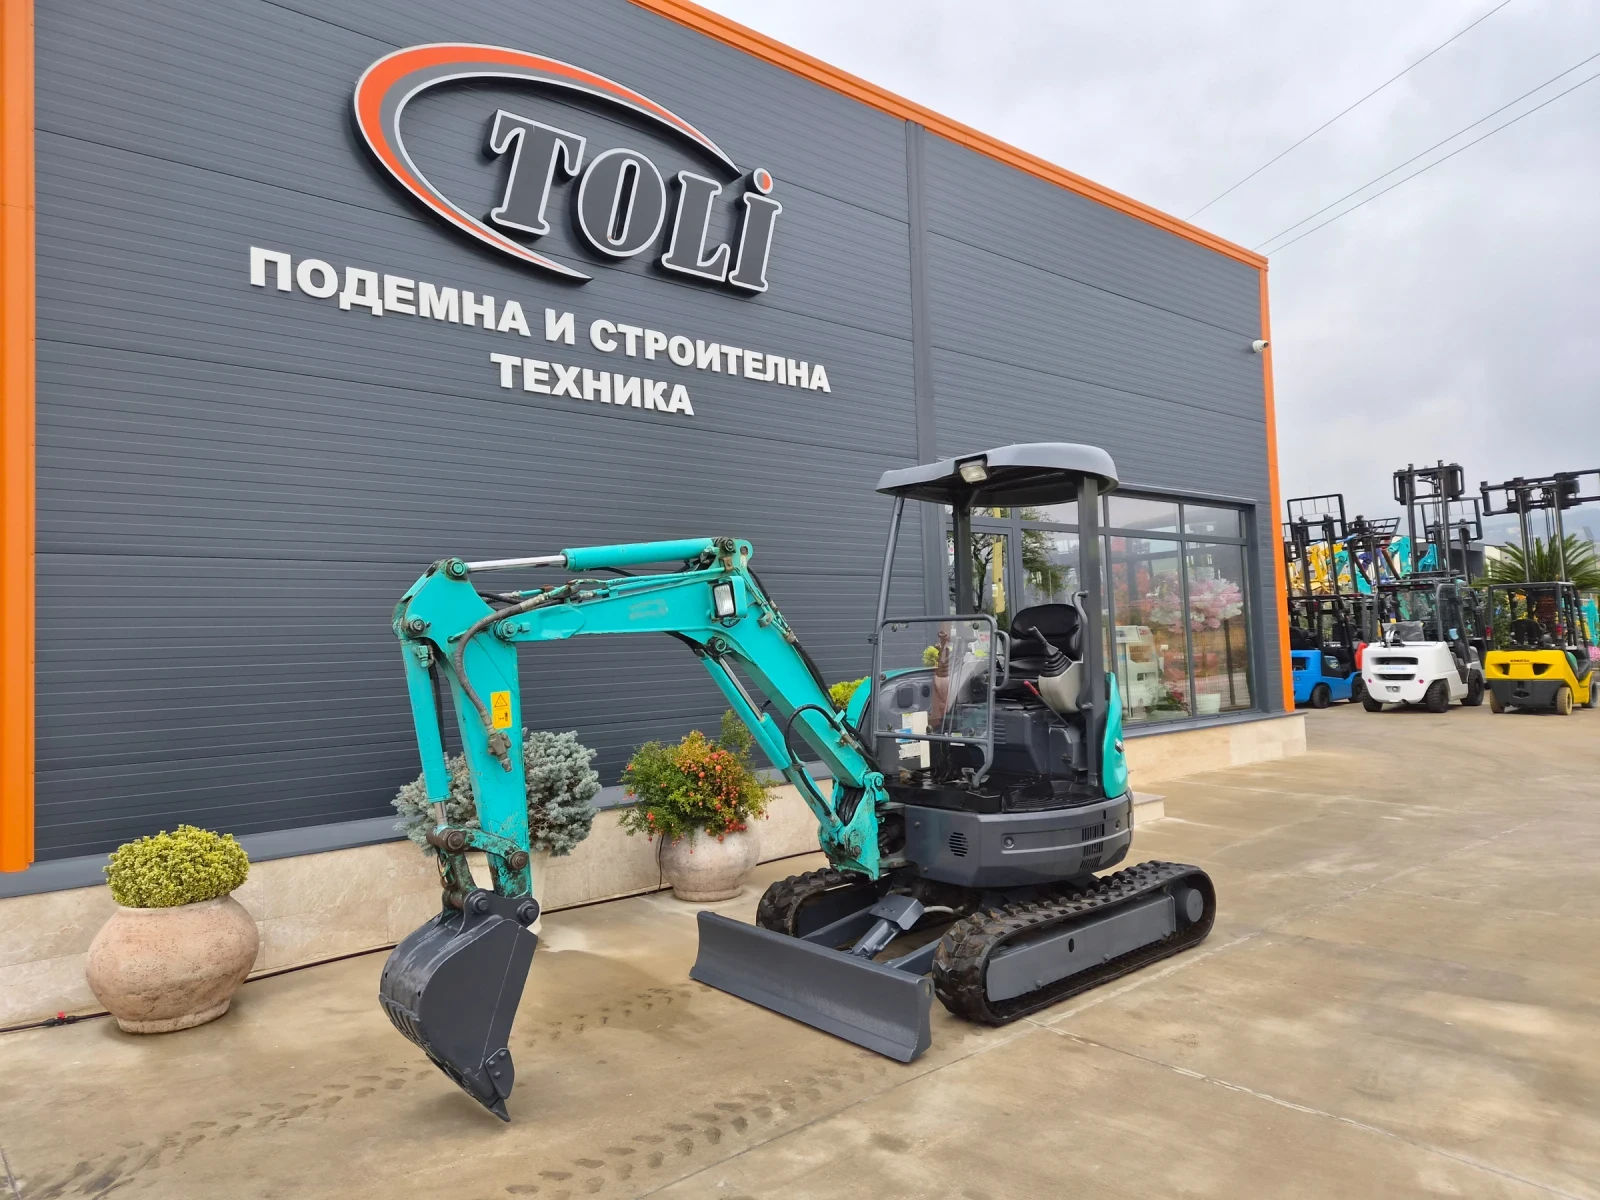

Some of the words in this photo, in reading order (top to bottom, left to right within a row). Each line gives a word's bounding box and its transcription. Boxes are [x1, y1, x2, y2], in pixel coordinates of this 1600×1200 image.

[250, 246, 531, 337] ПОДЕМНА
[545, 308, 576, 345] И
[589, 319, 832, 393] СТРОИТЕЛНА
[490, 353, 694, 416] ТЕХНИКА
